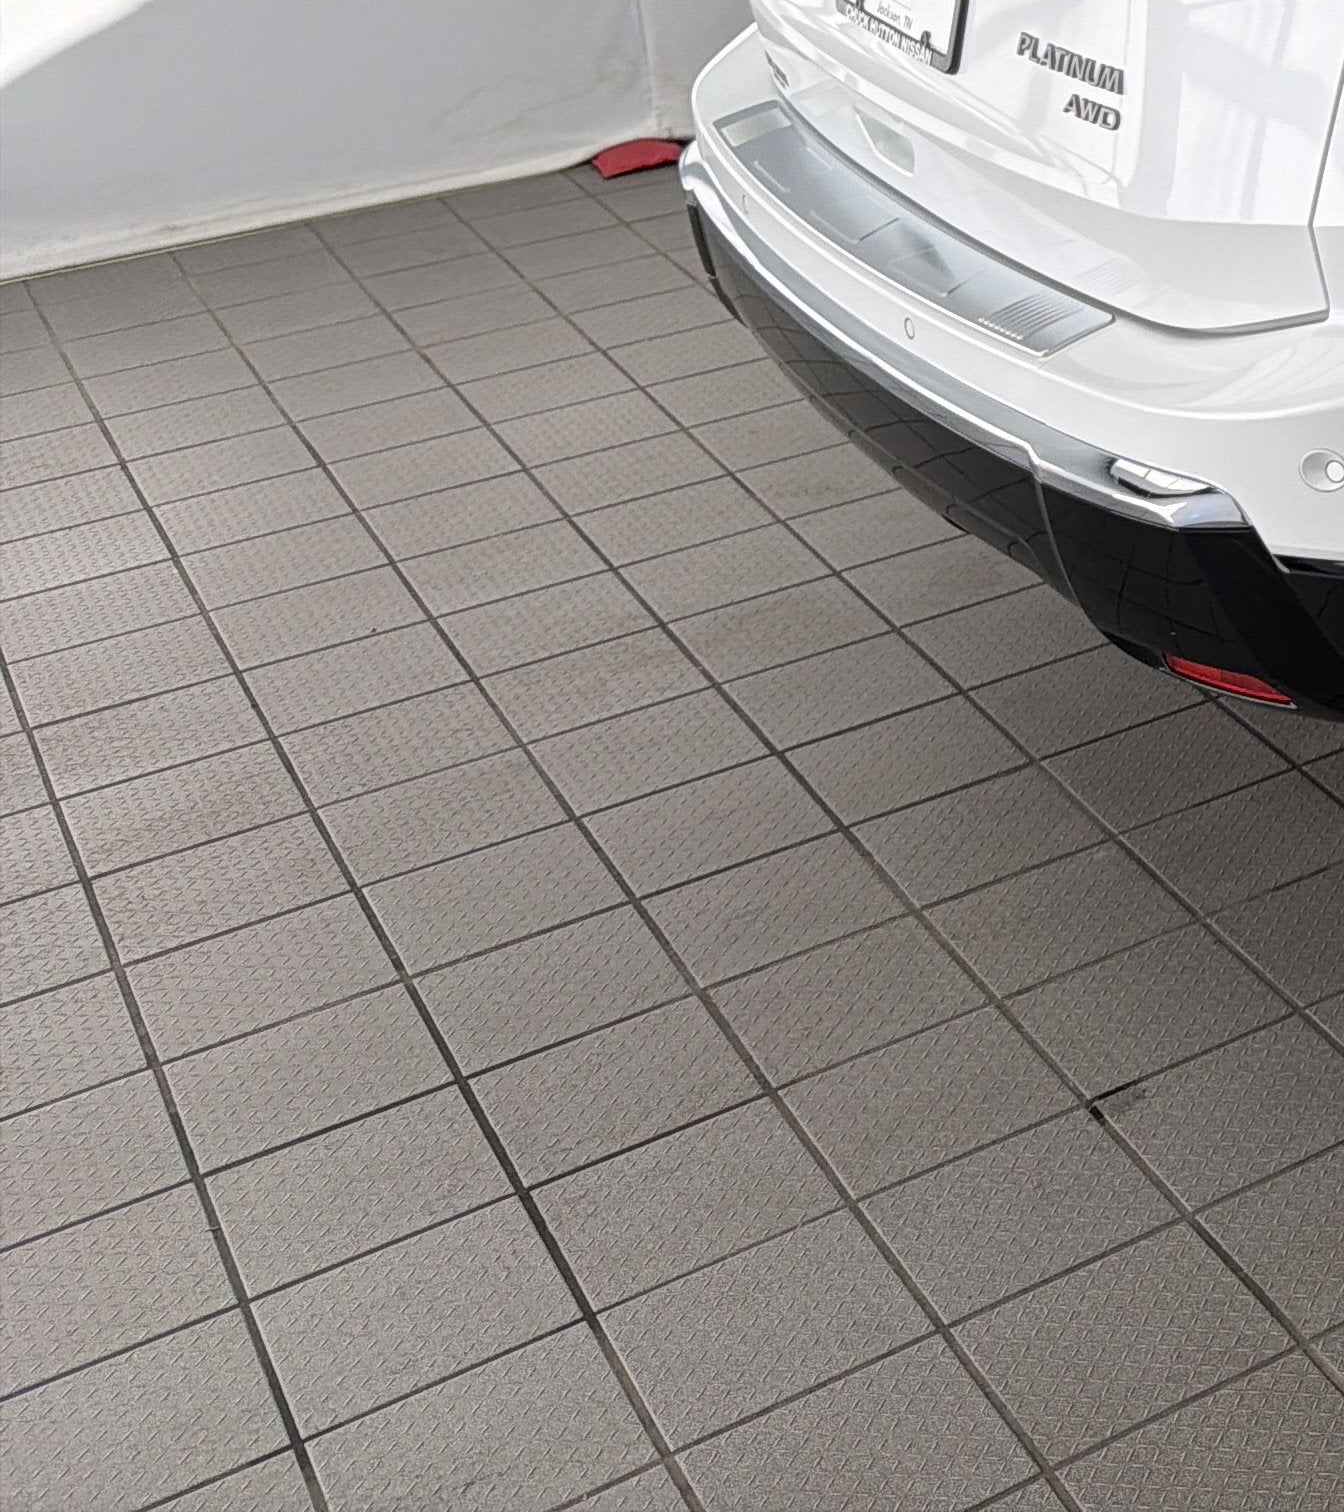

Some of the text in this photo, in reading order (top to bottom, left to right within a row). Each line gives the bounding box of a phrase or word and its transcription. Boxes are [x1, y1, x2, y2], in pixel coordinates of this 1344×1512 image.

[901, 35, 933, 66] NISSAN
[1017, 31, 1125, 95] PLATINUM
[1062, 93, 1121, 130] AWD
